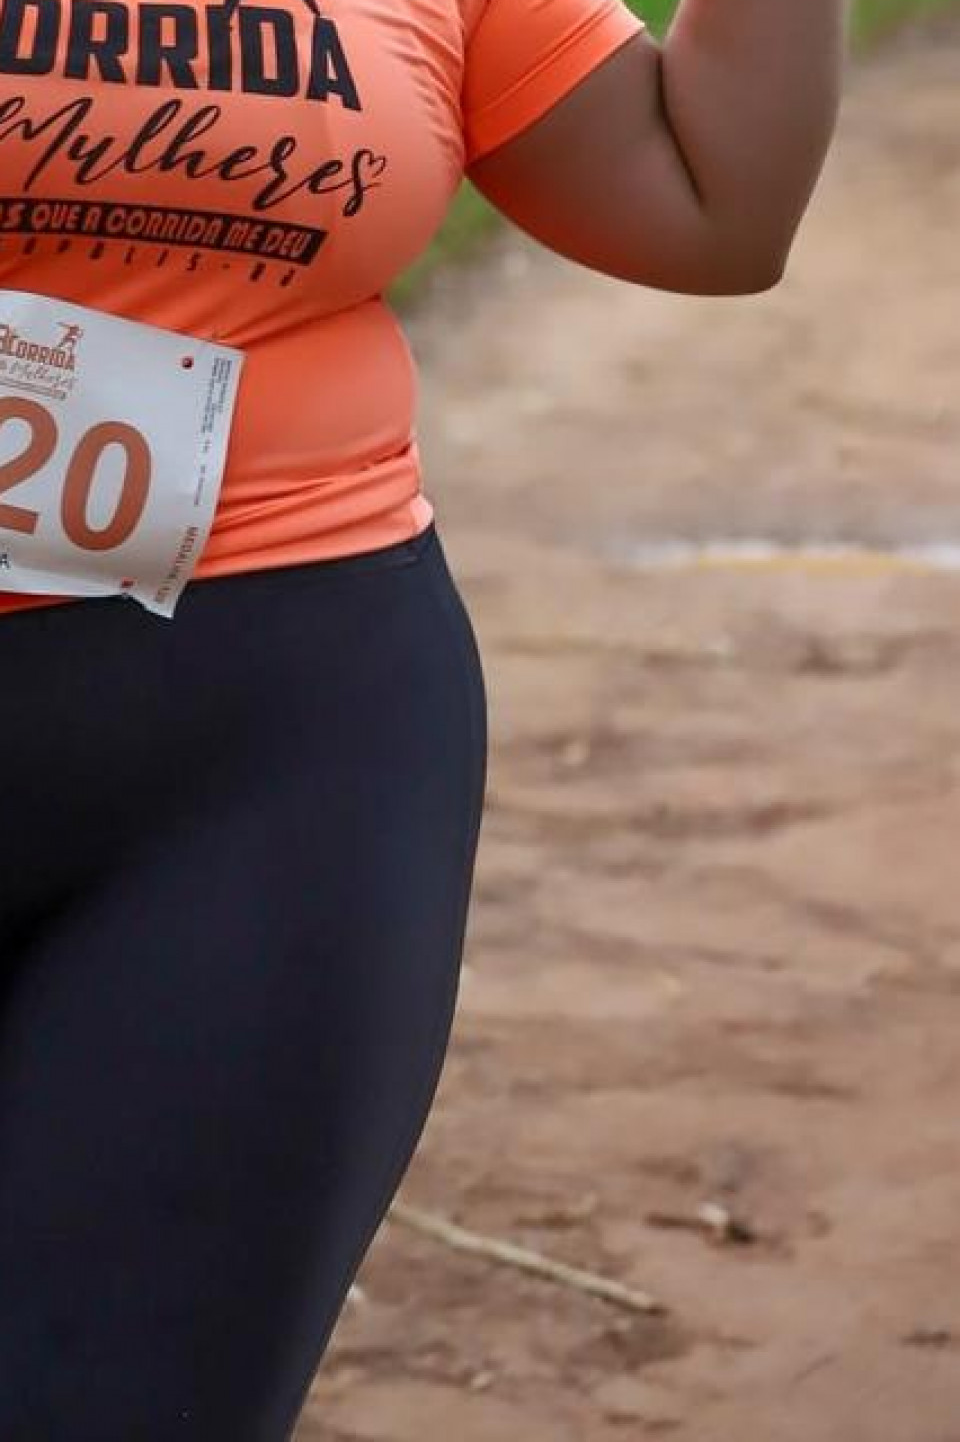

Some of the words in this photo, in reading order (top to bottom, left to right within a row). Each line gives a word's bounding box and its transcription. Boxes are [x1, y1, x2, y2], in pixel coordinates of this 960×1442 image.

[105, 207, 224, 245] CORRIDA
[222, 221, 263, 250] ME
[261, 228, 313, 260] DEU
